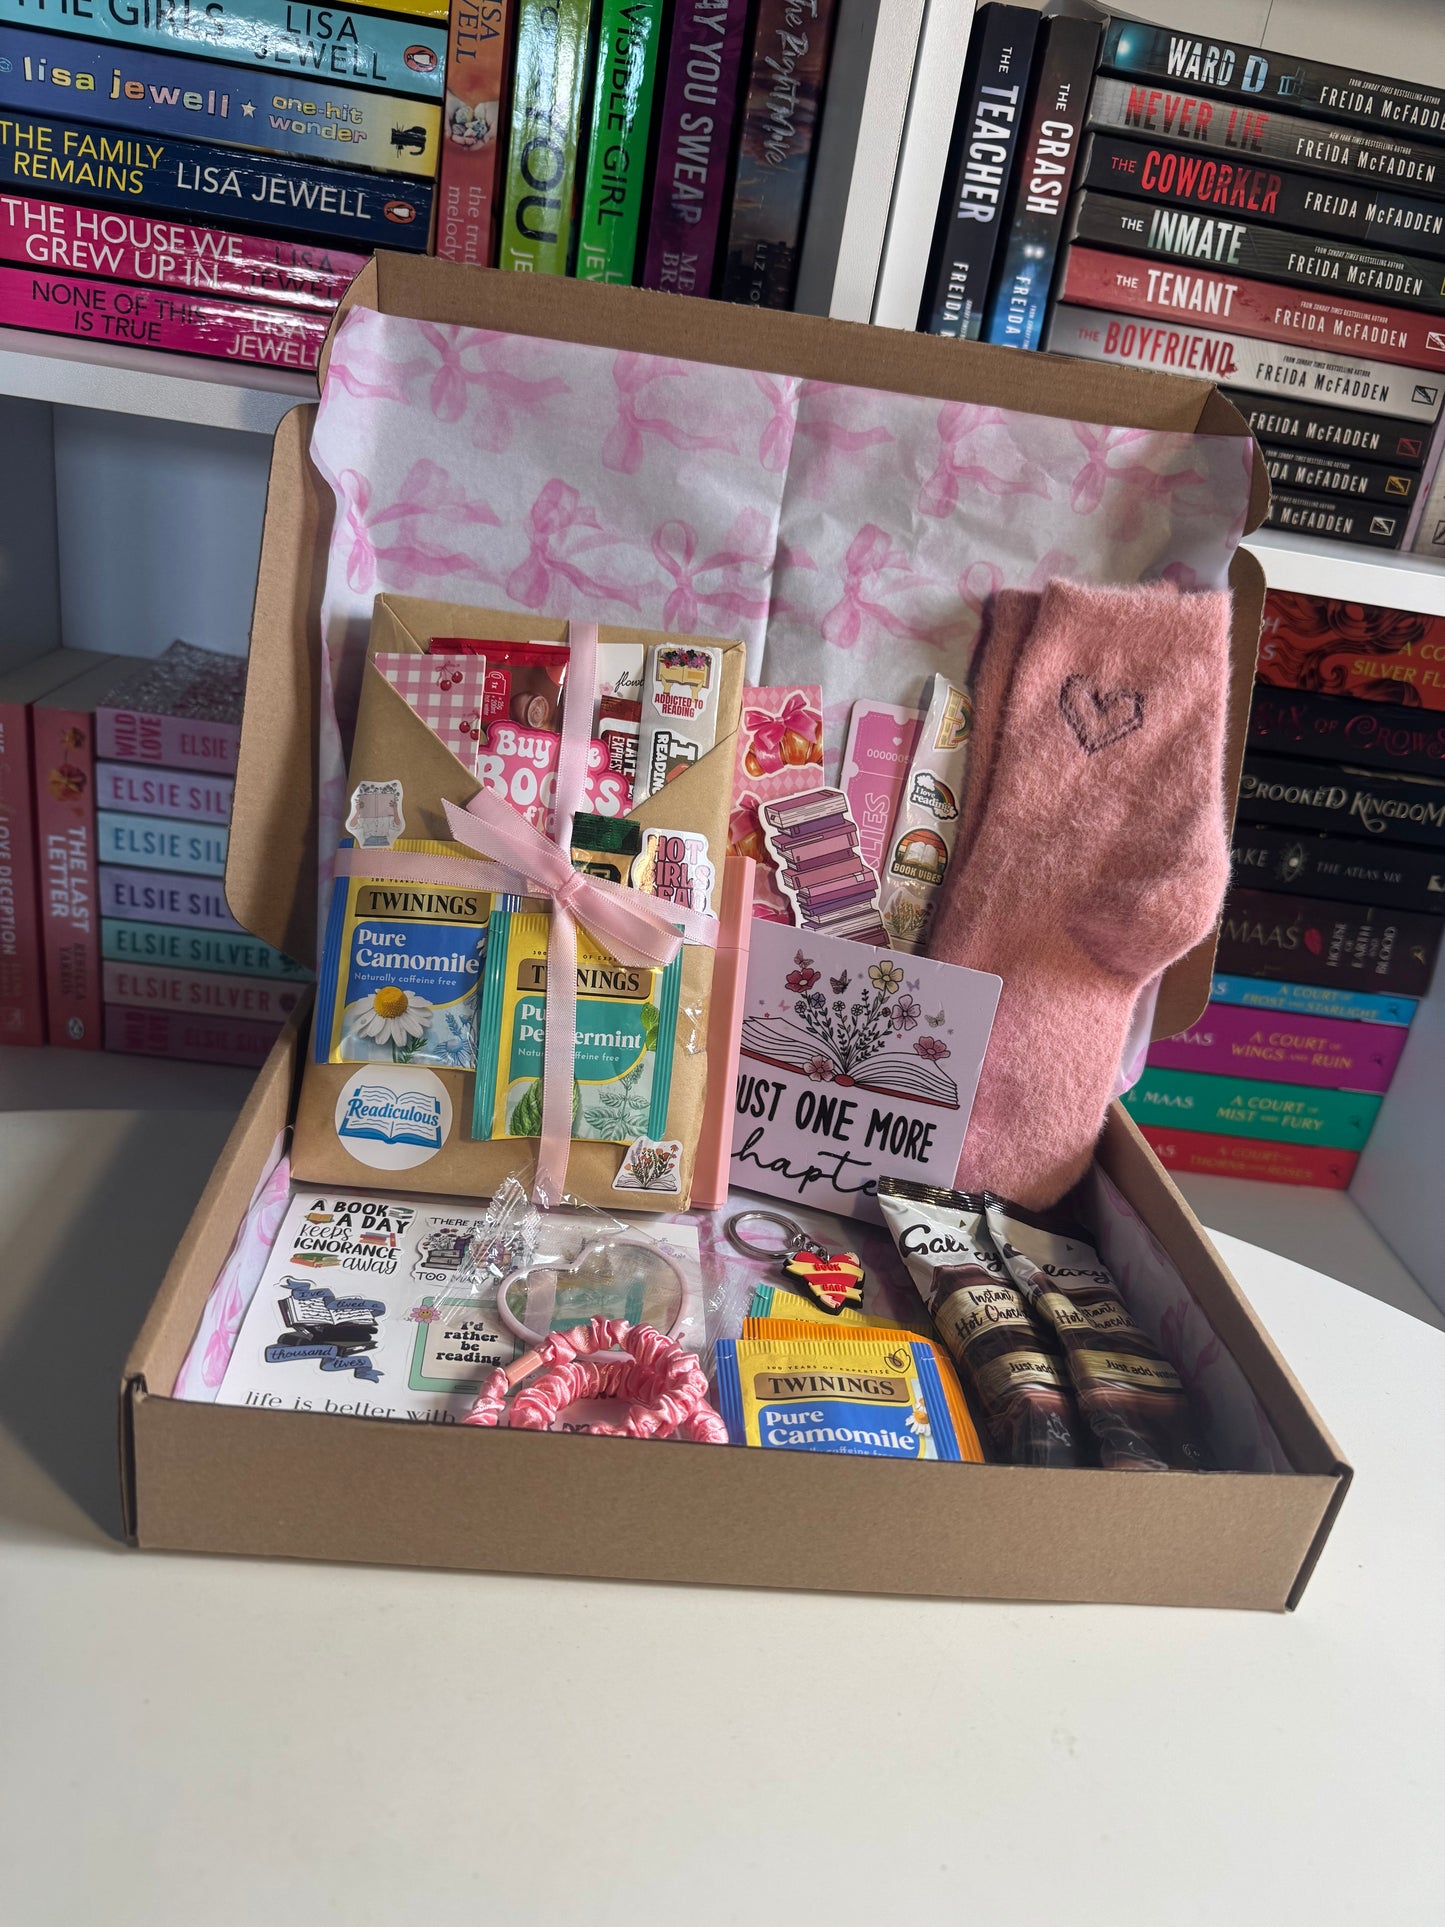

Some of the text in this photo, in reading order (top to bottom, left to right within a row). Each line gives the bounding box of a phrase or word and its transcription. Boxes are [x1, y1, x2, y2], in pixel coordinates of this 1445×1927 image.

[285, 5, 359, 43] LISA
[253, 35, 387, 81] JEWELL
[1167, 37, 1269, 93] WARD D
[23, 56, 229, 118] lisa jewell
[683, 42, 723, 105] YOU
[1320, 86, 1373, 114] FREIDA
[1349, 78, 1441, 105] FROM SUNDAY TIMES BESTSELLING AUTHOR
[272, 95, 363, 124] one-hit
[1125, 86, 1270, 153] NEVER LIE
[268, 114, 367, 143] wonder
[957, 47, 1020, 223] THE TEACHER
[0, 121, 165, 169] THE FAMILY
[1026, 83, 1074, 216] THE CRASH
[1351, 136, 1365, 145] TIMES
[1365, 139, 1394, 151] BESTSELLING
[1394, 145, 1412, 155] AUTHOR
[14, 152, 144, 194] REMAINS
[671, 112, 714, 224] SWEAR
[1296, 137, 1436, 183] FREIDA McFADDEN
[177, 162, 372, 219] LISA JEWELL
[598, 144, 630, 225] GIRL
[1111, 150, 1282, 215] THE COWORKER
[469, 186, 486, 219] the
[1304, 191, 1444, 235] FREIDA McFADDEN
[0, 197, 243, 262] THE HOUSE WE
[1121, 209, 1247, 265] THE INMATE
[26, 235, 219, 288] GREW UP IN
[753, 244, 767, 271] LIZ
[1345, 251, 1359, 262] TIMES
[1359, 255, 1387, 267] BESTSELLING
[1288, 253, 1423, 296] FREIDA McFADDEN
[32, 280, 206, 325] NONE OF THIS
[943, 262, 969, 321] FREIDA
[1005, 276, 1031, 335] FREIDA
[1115, 269, 1238, 317] THE TENANT
[74, 312, 162, 343] IS TRUE
[1274, 307, 1408, 349] FREIDA McFADDEN
[1330, 306, 1343, 315] TIMES
[1343, 309, 1371, 321] BESTSELLING
[1078, 327, 1100, 342] THE
[1103, 321, 1237, 378] BOYFRIEND
[1255, 363, 1390, 402] FREIDA McFADDEN
[1249, 412, 1381, 450] FREIDA McFADDEN
[1294, 466, 1369, 494] McFADDEN
[1280, 507, 1354, 534] McFADDEN
[1351, 659, 1417, 681] SILVER
[654, 693, 704, 710] ADDICTED TO
[662, 704, 695, 718] READING
[114, 713, 137, 757] WILD
[139, 716, 162, 760] LOVE
[180, 733, 228, 760] ELSIE
[497, 730, 551, 768] Buy
[112, 777, 181, 807] ELSIE
[1239, 773, 1445, 834] CROOKED KINGDOM
[113, 827, 181, 857] ELSIE
[47, 835, 68, 917] LETTER
[68, 826, 90, 933] THE LAST
[893, 863, 942, 883] BOOK VIBES
[114, 883, 180, 912] ELSIE
[369, 891, 477, 916] TWININGS
[357, 928, 407, 947] Pure
[1221, 918, 1300, 950] MAAS
[116, 930, 271, 969] ELSIE SILVER
[355, 948, 480, 974] Camomile
[117, 973, 271, 1012] ELSIE SILVER
[354, 972, 457, 986] Naturally caffeine free
[532, 965, 640, 991] TNINGS
[519, 1024, 641, 1049] Peermint
[1269, 1033, 1326, 1051] COURT
[602, 1053, 620, 1062] free
[1231, 1044, 1353, 1069] WINGS RUIN
[348, 1098, 439, 1126] Readiculous
[1216, 1107, 1324, 1131] MIST FURY
[1247, 1096, 1305, 1114] COURT
[795, 1091, 937, 1163] ONE MORE
[310, 1199, 389, 1218] A BOOK
[430, 1217, 468, 1227] THERE
[336, 1213, 409, 1235] A DAY
[293, 1237, 401, 1261] IGNORANCE
[342, 1257, 398, 1275] away
[415, 1271, 447, 1282] TOO
[337, 1300, 365, 1309] lived
[968, 1289, 1015, 1306] Instant
[955, 1310, 983, 1339] Hot
[1054, 1309, 1083, 1325] Hot
[444, 1330, 498, 1343] rather
[460, 1340, 480, 1352] be
[270, 1347, 335, 1361] thousand
[334, 1358, 367, 1369] lives
[435, 1350, 502, 1367] reading
[1008, 1361, 1033, 1373] Just
[1105, 1359, 1152, 1376] Just add
[768, 1376, 895, 1395] TWININGS
[244, 1391, 283, 1408] life
[294, 1396, 312, 1411] is
[325, 1399, 396, 1419] better
[765, 1410, 824, 1426] Pure
[767, 1427, 915, 1450] Camomile
